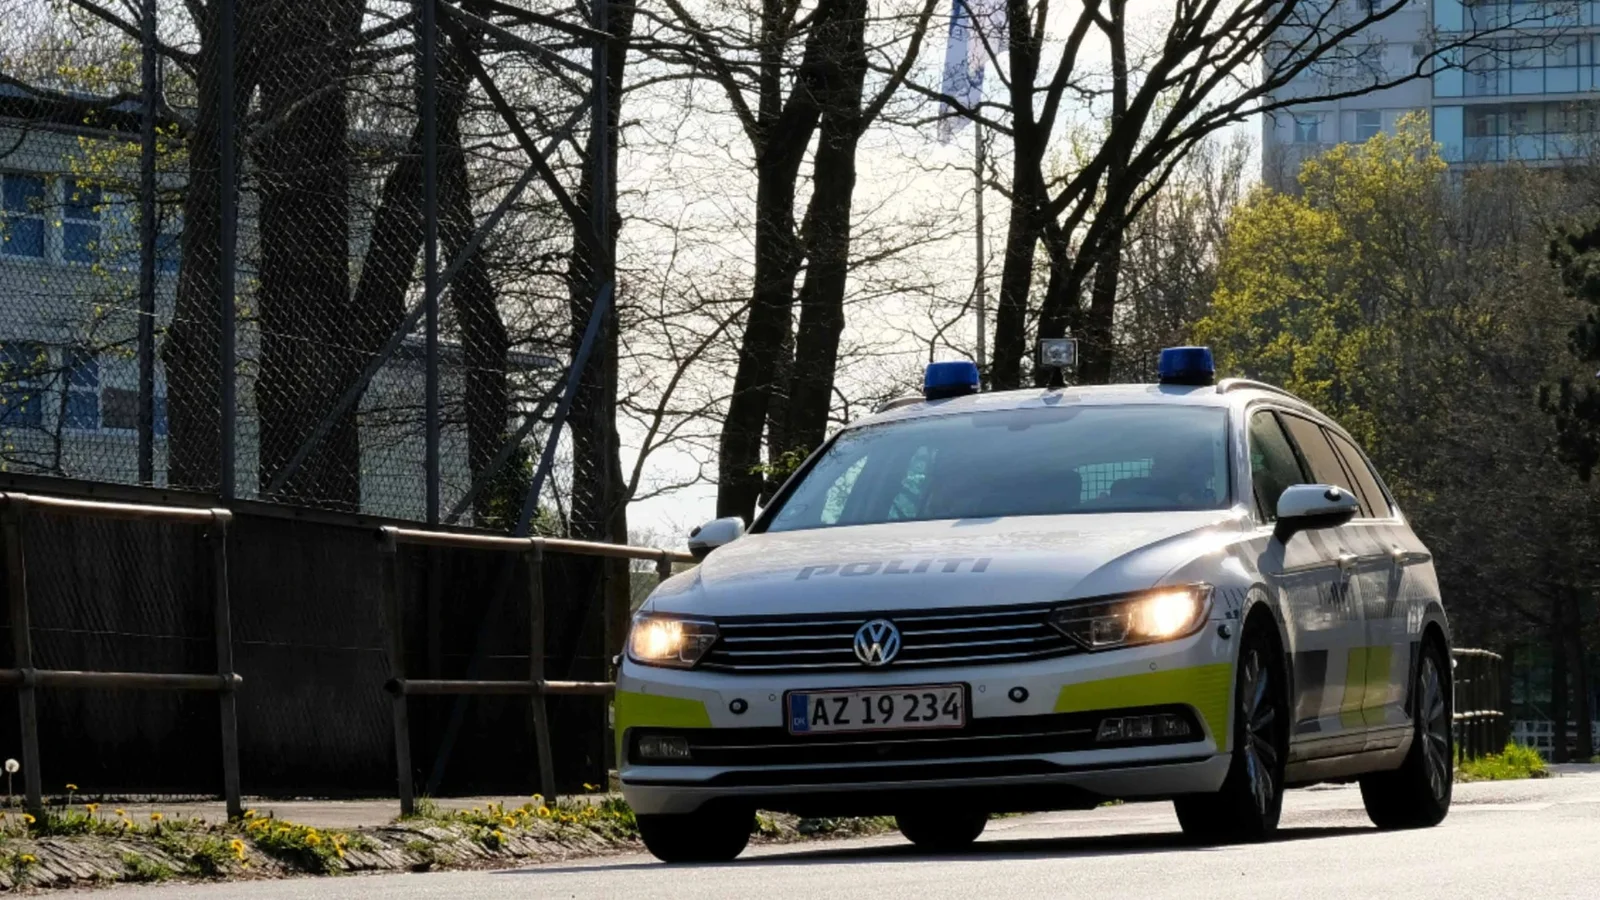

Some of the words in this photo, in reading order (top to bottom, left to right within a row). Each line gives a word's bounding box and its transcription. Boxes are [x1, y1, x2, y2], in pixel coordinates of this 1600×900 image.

[795, 558, 992, 581] POLITI
[811, 697, 850, 726] AZ
[861, 695, 895, 724] 19
[903, 692, 959, 722] 234
[793, 717, 806, 726] DK
